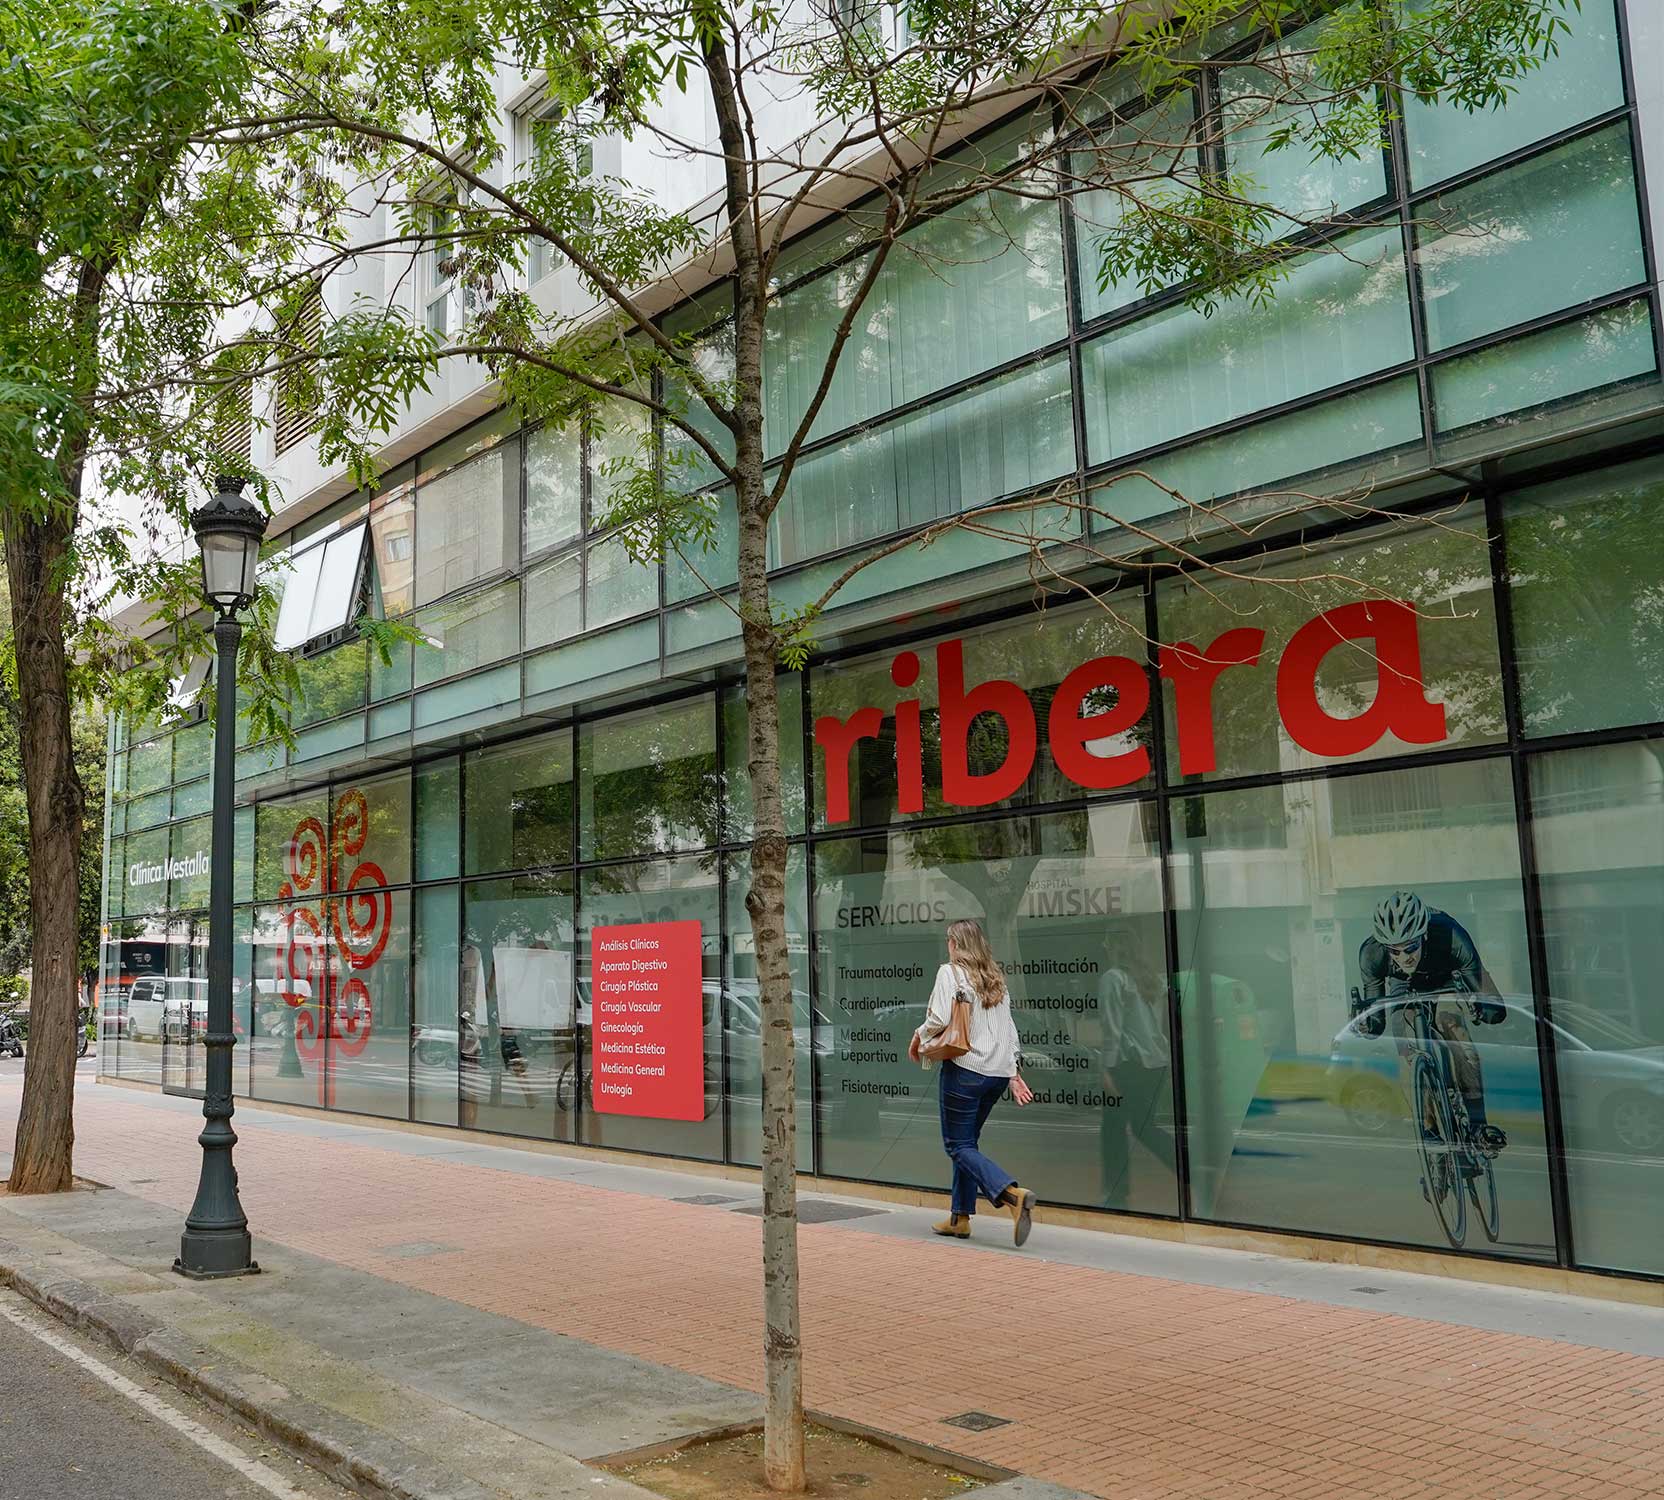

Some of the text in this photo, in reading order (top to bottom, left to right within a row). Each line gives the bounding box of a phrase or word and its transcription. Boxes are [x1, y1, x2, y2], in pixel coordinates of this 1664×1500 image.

[815, 600, 1447, 824] ribera
[129, 850, 209, 886] Clínica Mestalla
[1027, 878, 1073, 890] HOSPITAL
[1029, 886, 1122, 918] IMSKE
[838, 901, 946, 928] SERVICIOS
[600, 938, 659, 951] Análisis Clínicos
[600, 959, 667, 973] Aparato Digestivo
[838, 963, 923, 981] Traumatología
[998, 957, 1098, 975] Rehabilitación
[600, 980, 658, 994] Cirugía Plástica
[600, 1001, 662, 1014] Cirugía Vascular
[1010, 993, 1098, 1013] eumatología
[601, 1022, 644, 1036] Ginecología
[840, 1029, 891, 1042] Medicina
[1018, 1030, 1071, 1045] idad de
[601, 1043, 665, 1055] Medicina Estética
[841, 1049, 898, 1065] Deportiva
[1019, 1053, 1088, 1073] romialgia
[601, 1063, 665, 1077] Medicina General
[601, 1083, 632, 1097] Urología
[842, 1080, 910, 1098] Fisioterapia
[1056, 1089, 1078, 1105] del
[1083, 1090, 1123, 1107] dolor
